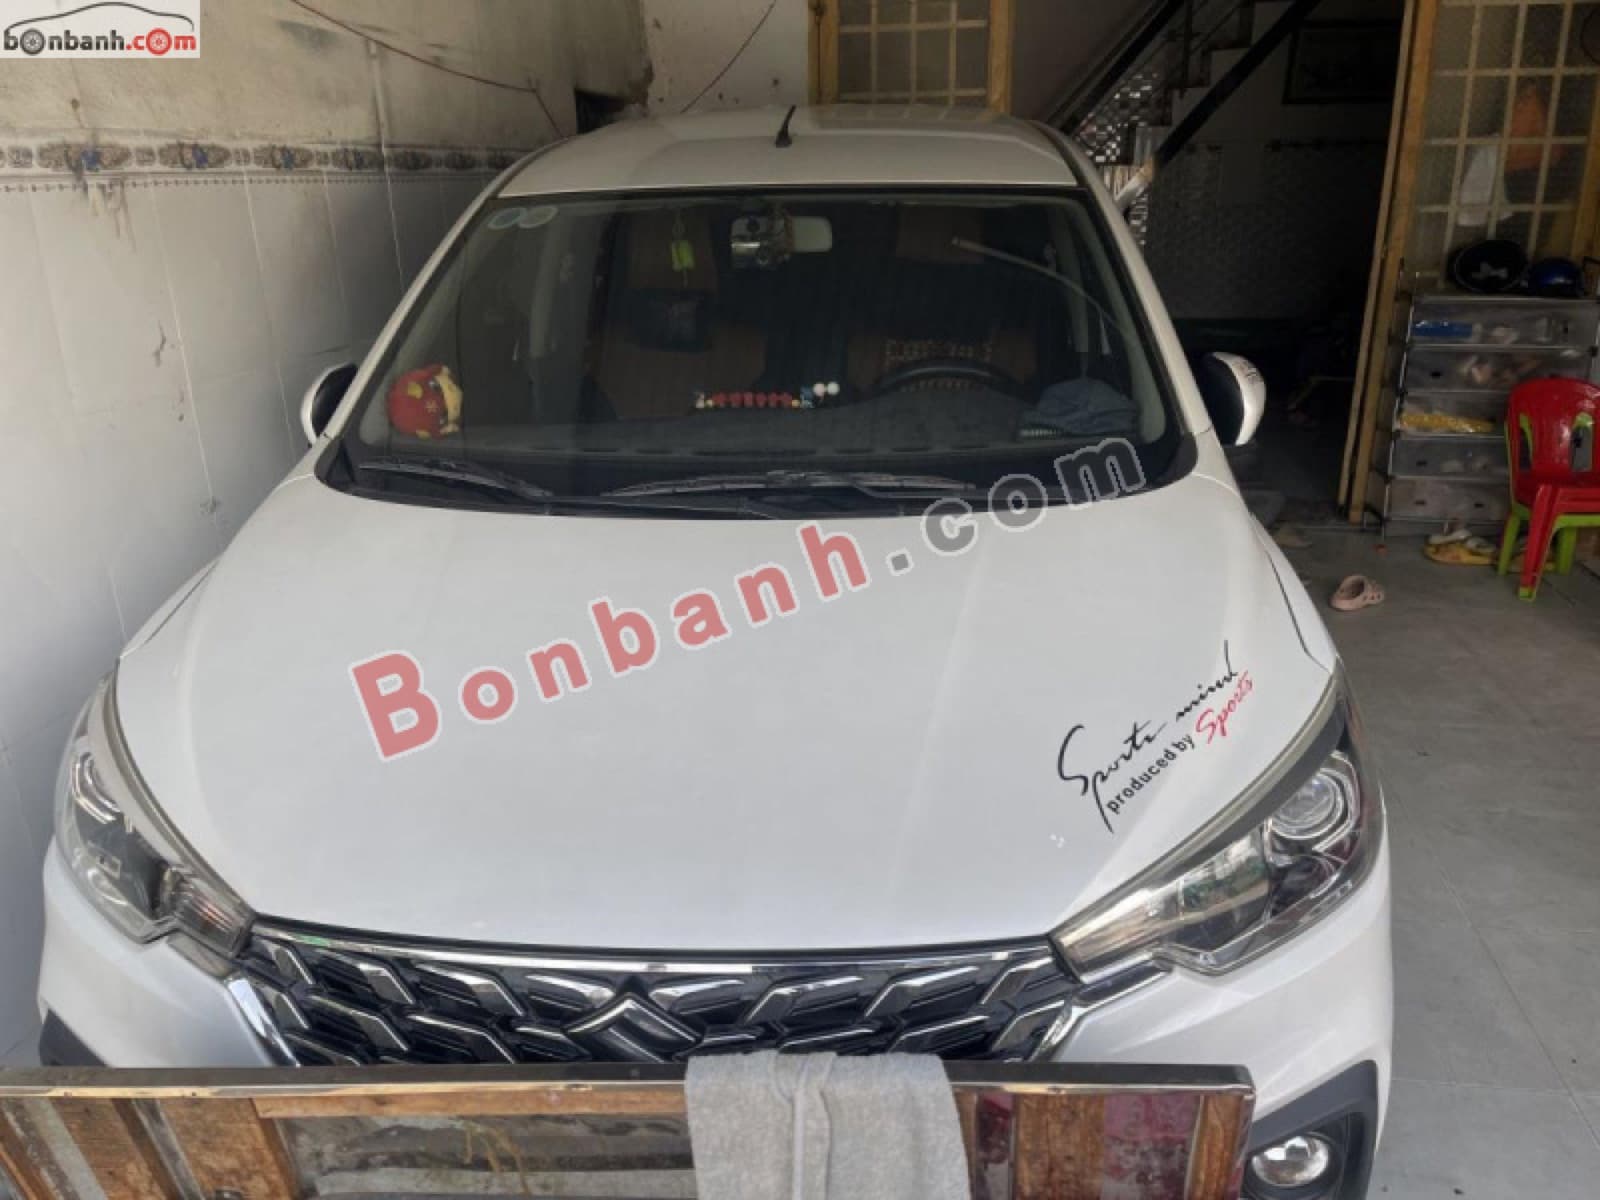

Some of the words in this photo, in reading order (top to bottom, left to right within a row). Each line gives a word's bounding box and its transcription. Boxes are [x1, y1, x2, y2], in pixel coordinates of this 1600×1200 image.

[1106, 745, 1177, 815] produced
[1173, 733, 1196, 751] by
[1195, 669, 1253, 744] Sports
